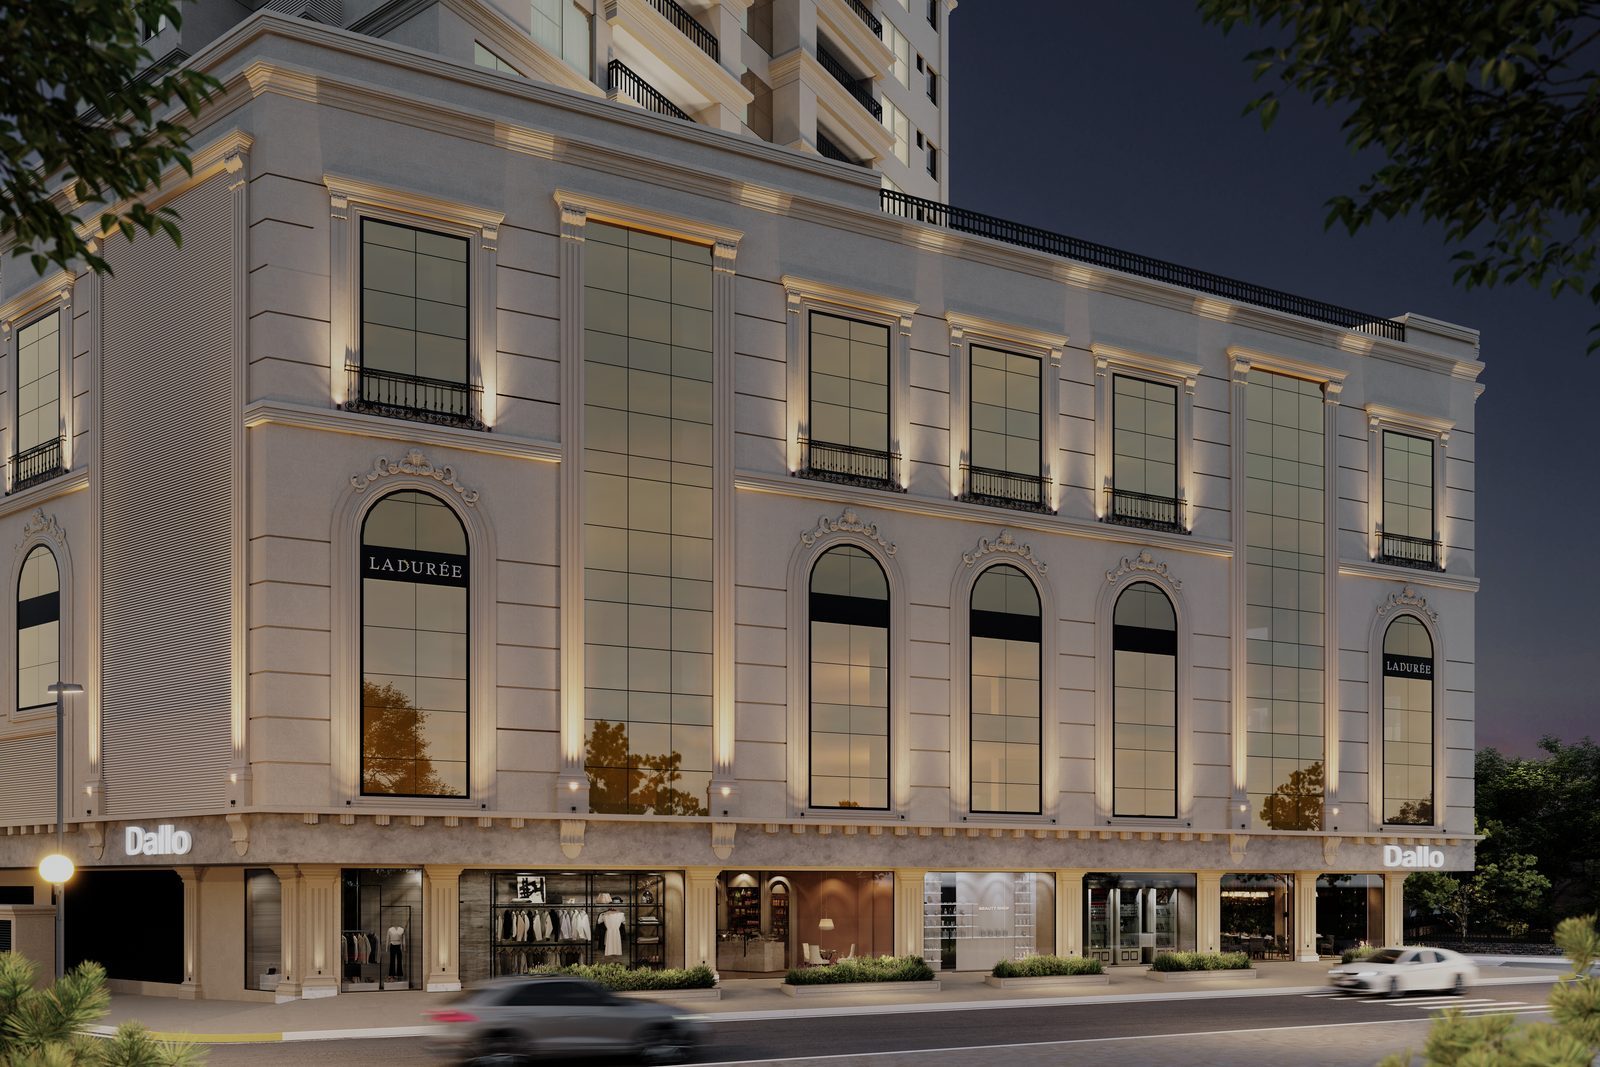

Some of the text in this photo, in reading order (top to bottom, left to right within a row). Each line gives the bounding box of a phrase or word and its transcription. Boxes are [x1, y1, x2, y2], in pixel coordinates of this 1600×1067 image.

[369, 556, 462, 578] LADURÉE
[1386, 661, 1432, 675] LADURÉE
[125, 824, 192, 856] Dallo
[1383, 845, 1445, 868] Dallo
